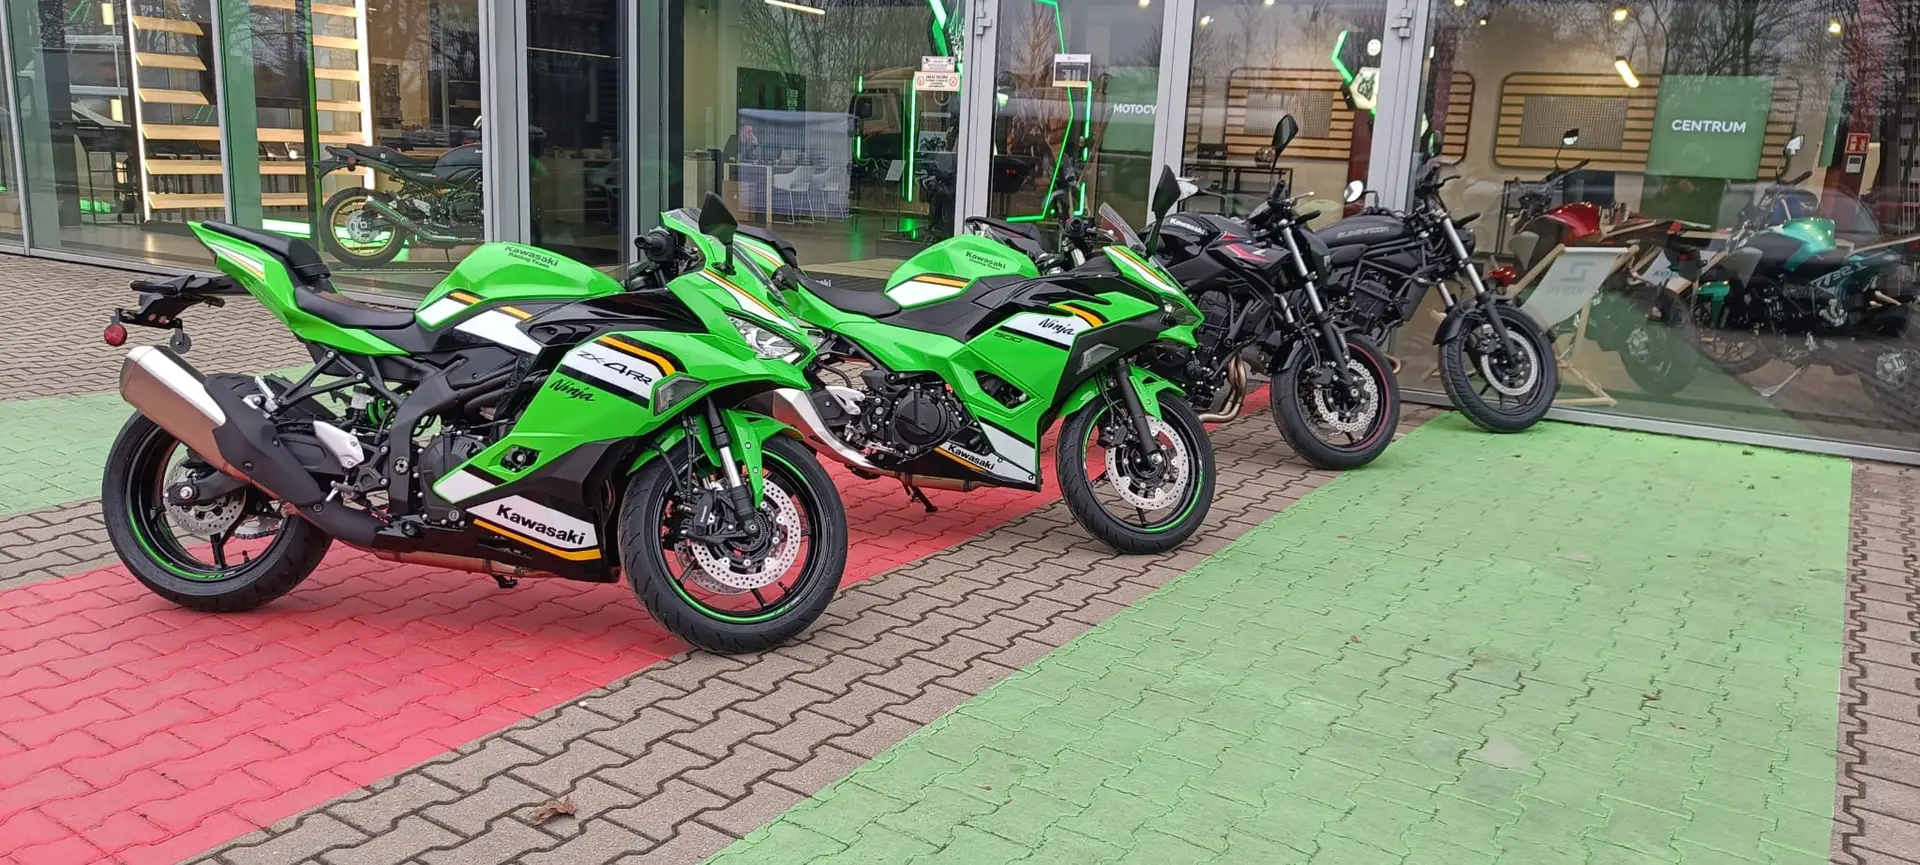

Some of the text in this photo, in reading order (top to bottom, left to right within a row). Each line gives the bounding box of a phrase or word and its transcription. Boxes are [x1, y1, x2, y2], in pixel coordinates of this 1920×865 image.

[1113, 103, 1157, 114] MOTOCY
[1671, 119, 1747, 133] CENTRUM
[1169, 218, 1206, 236] Kawasaki
[504, 245, 559, 267] Kawasaki
[508, 252, 550, 269] Racing Team
[965, 250, 1006, 269] Kawasaki
[1038, 318, 1075, 336] Ninja
[993, 331, 1023, 344] 500
[576, 349, 653, 386] ZX-4RR
[549, 378, 596, 402] Ninja
[948, 444, 996, 470] Kawasaki
[496, 503, 586, 545] Kawasaki
